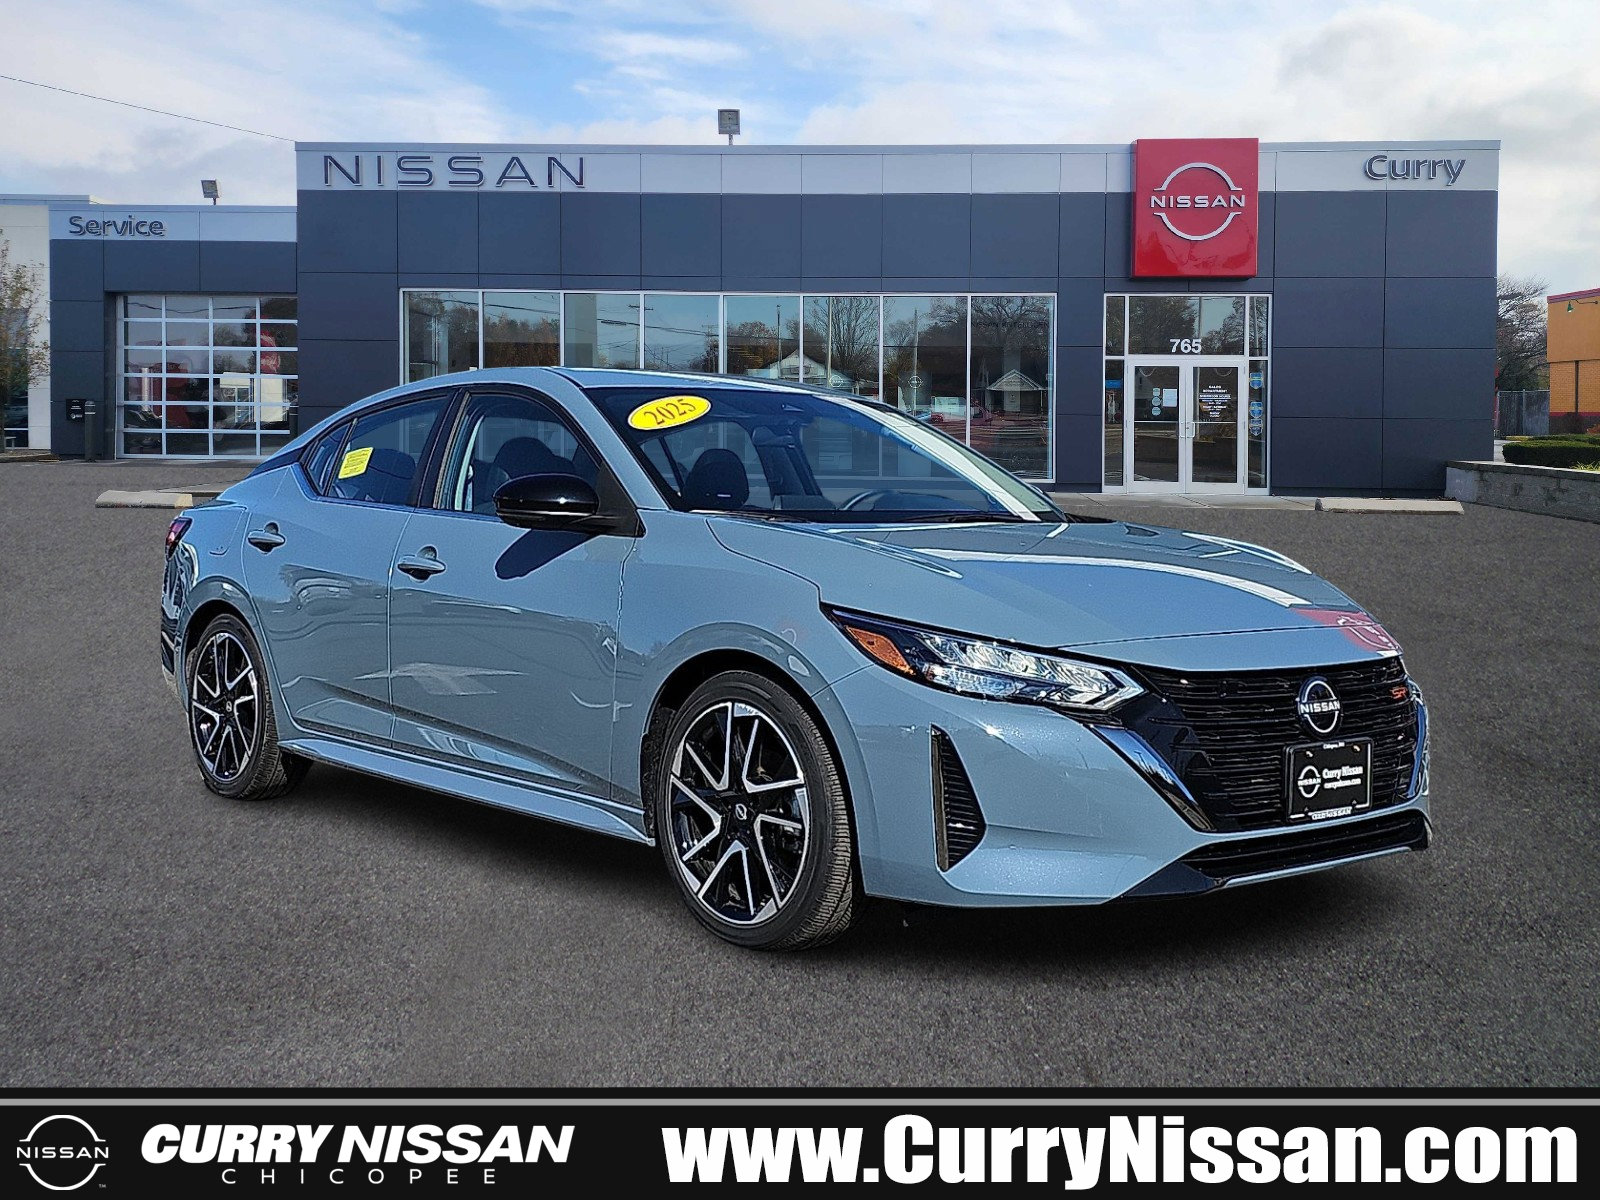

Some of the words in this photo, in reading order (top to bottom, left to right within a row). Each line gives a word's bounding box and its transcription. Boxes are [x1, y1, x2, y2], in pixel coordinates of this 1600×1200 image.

[323, 155, 585, 188] NISSAN
[1364, 154, 1466, 186] Curry
[1150, 195, 1246, 208] NISSAN
[69, 214, 165, 236] Service
[1170, 338, 1202, 354] 765
[643, 398, 697, 425] 2025
[1300, 701, 1341, 714] NISSAN
[1322, 768, 1342, 780] Curry
[1341, 766, 1364, 777] Nissan
[1297, 777, 1322, 786] NISSAN
